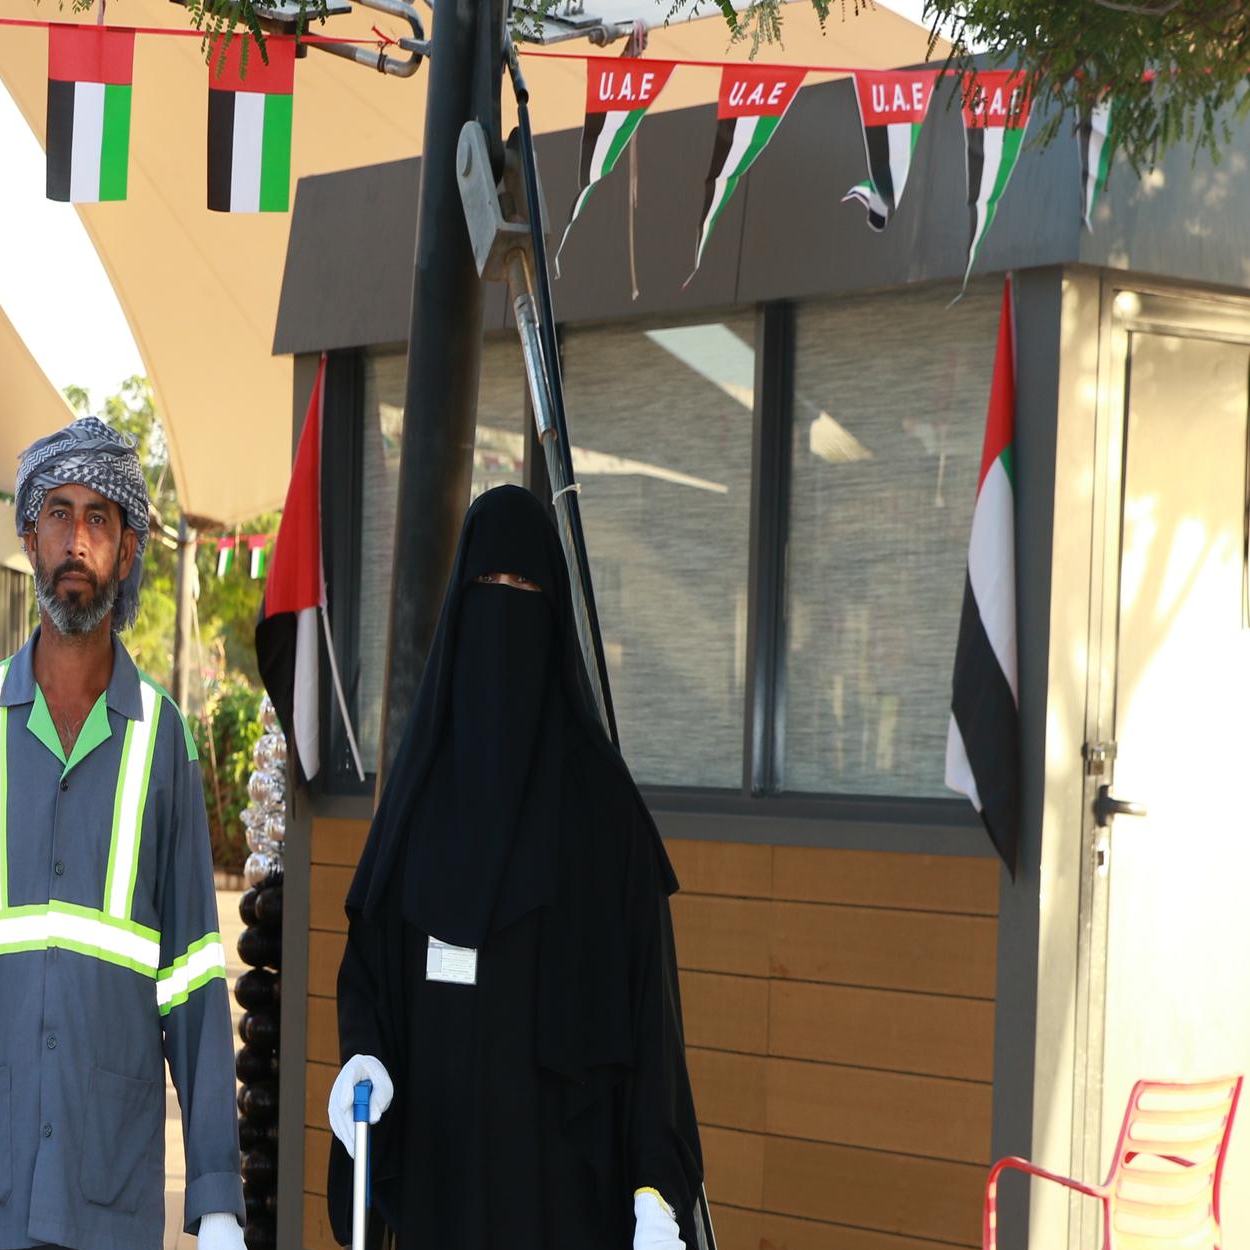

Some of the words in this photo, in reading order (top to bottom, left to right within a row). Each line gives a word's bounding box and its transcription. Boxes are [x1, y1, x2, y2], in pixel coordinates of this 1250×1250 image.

[600, 72, 654, 101] U.A.E
[728, 81, 786, 106] U.A.E
[872, 82, 923, 113] U.A.E
